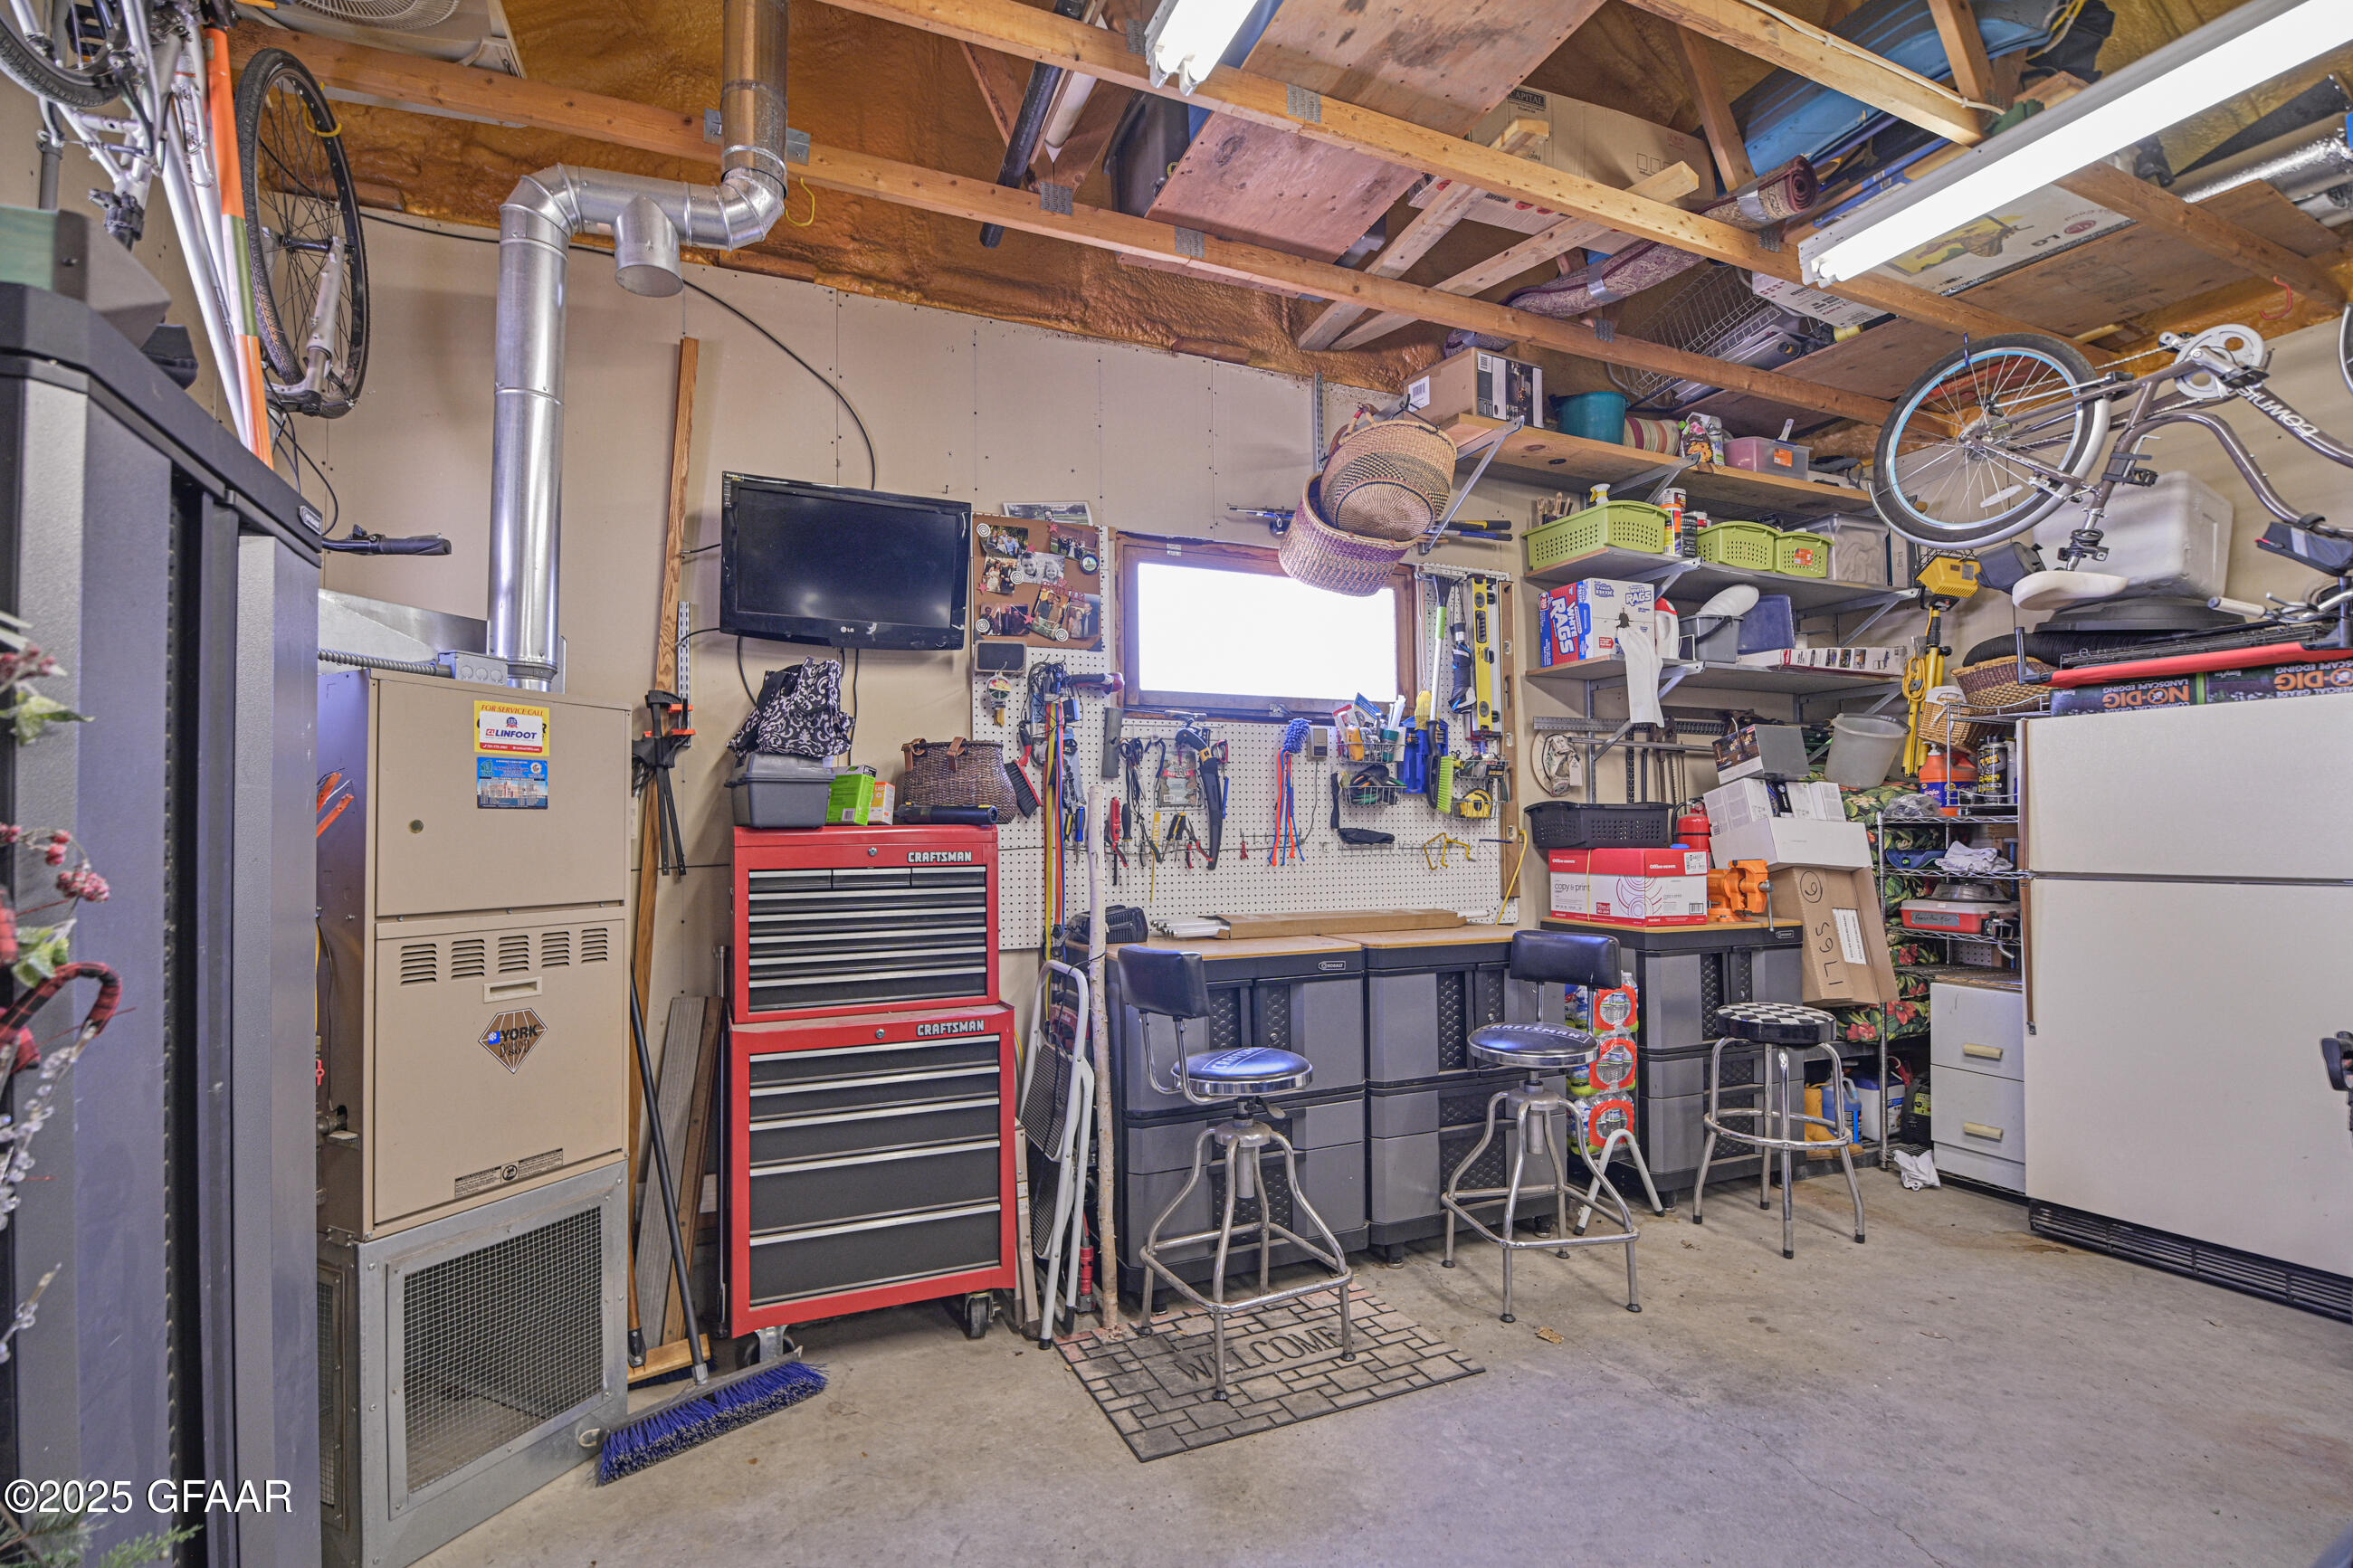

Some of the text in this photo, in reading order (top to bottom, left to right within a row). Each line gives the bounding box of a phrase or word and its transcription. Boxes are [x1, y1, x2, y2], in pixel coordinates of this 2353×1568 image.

[2030, 233, 2061, 246] LG
[1625, 590, 1652, 605] RAGS
[1550, 597, 1575, 654] RAGS
[1567, 601, 1578, 638] WHITE
[2275, 660, 2353, 674] SCAPE EDGING
[2273, 667, 2353, 690] O-DIG
[2102, 679, 2189, 694] LANDSCAPE EDGING
[2102, 685, 2190, 708] NO-DIG
[499, 707, 527, 716] SERVICE
[495, 729, 538, 739] LINFOOT
[908, 851, 973, 863] CRAFTSMAN
[1555, 884, 1570, 892] copy
[1575, 884, 1590, 893] print
[500, 1024, 538, 1041] YORK
[917, 1020, 985, 1036] CRAFTSMAN
